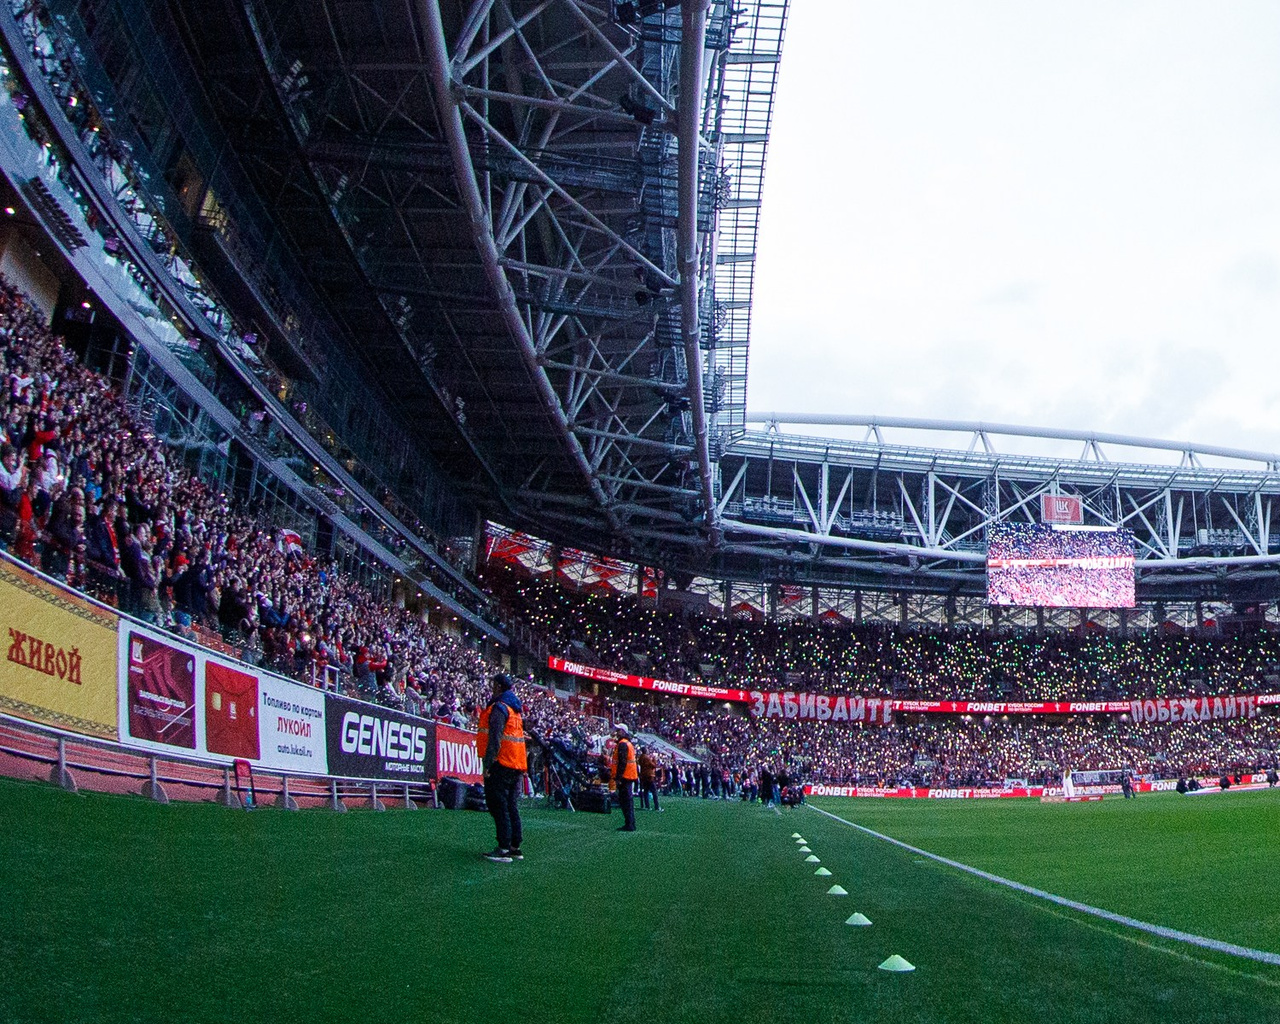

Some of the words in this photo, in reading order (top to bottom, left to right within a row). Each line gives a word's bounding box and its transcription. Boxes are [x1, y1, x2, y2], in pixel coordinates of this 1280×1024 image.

[7, 627, 82, 685] ЖИВОЙ
[564, 661, 596, 677] FONBET
[652, 680, 690, 694] FONBET
[263, 692, 291, 712] Топливо
[292, 704, 300, 714] по
[301, 706, 322, 719] картам
[750, 690, 893, 723] ЗАБИВАЙТЕ
[967, 703, 1006, 712] FONBET
[1069, 702, 1107, 712] FONBET
[1131, 694, 1256, 723] ПОБЕЖДАЙТЕ
[277, 716, 312, 738] ЛУКОЙЛ
[341, 711, 427, 762] GENESIS
[439, 739, 484, 775] ЛУКОЙ
[810, 785, 855, 796] FONBET
[928, 788, 972, 798] FONBET
